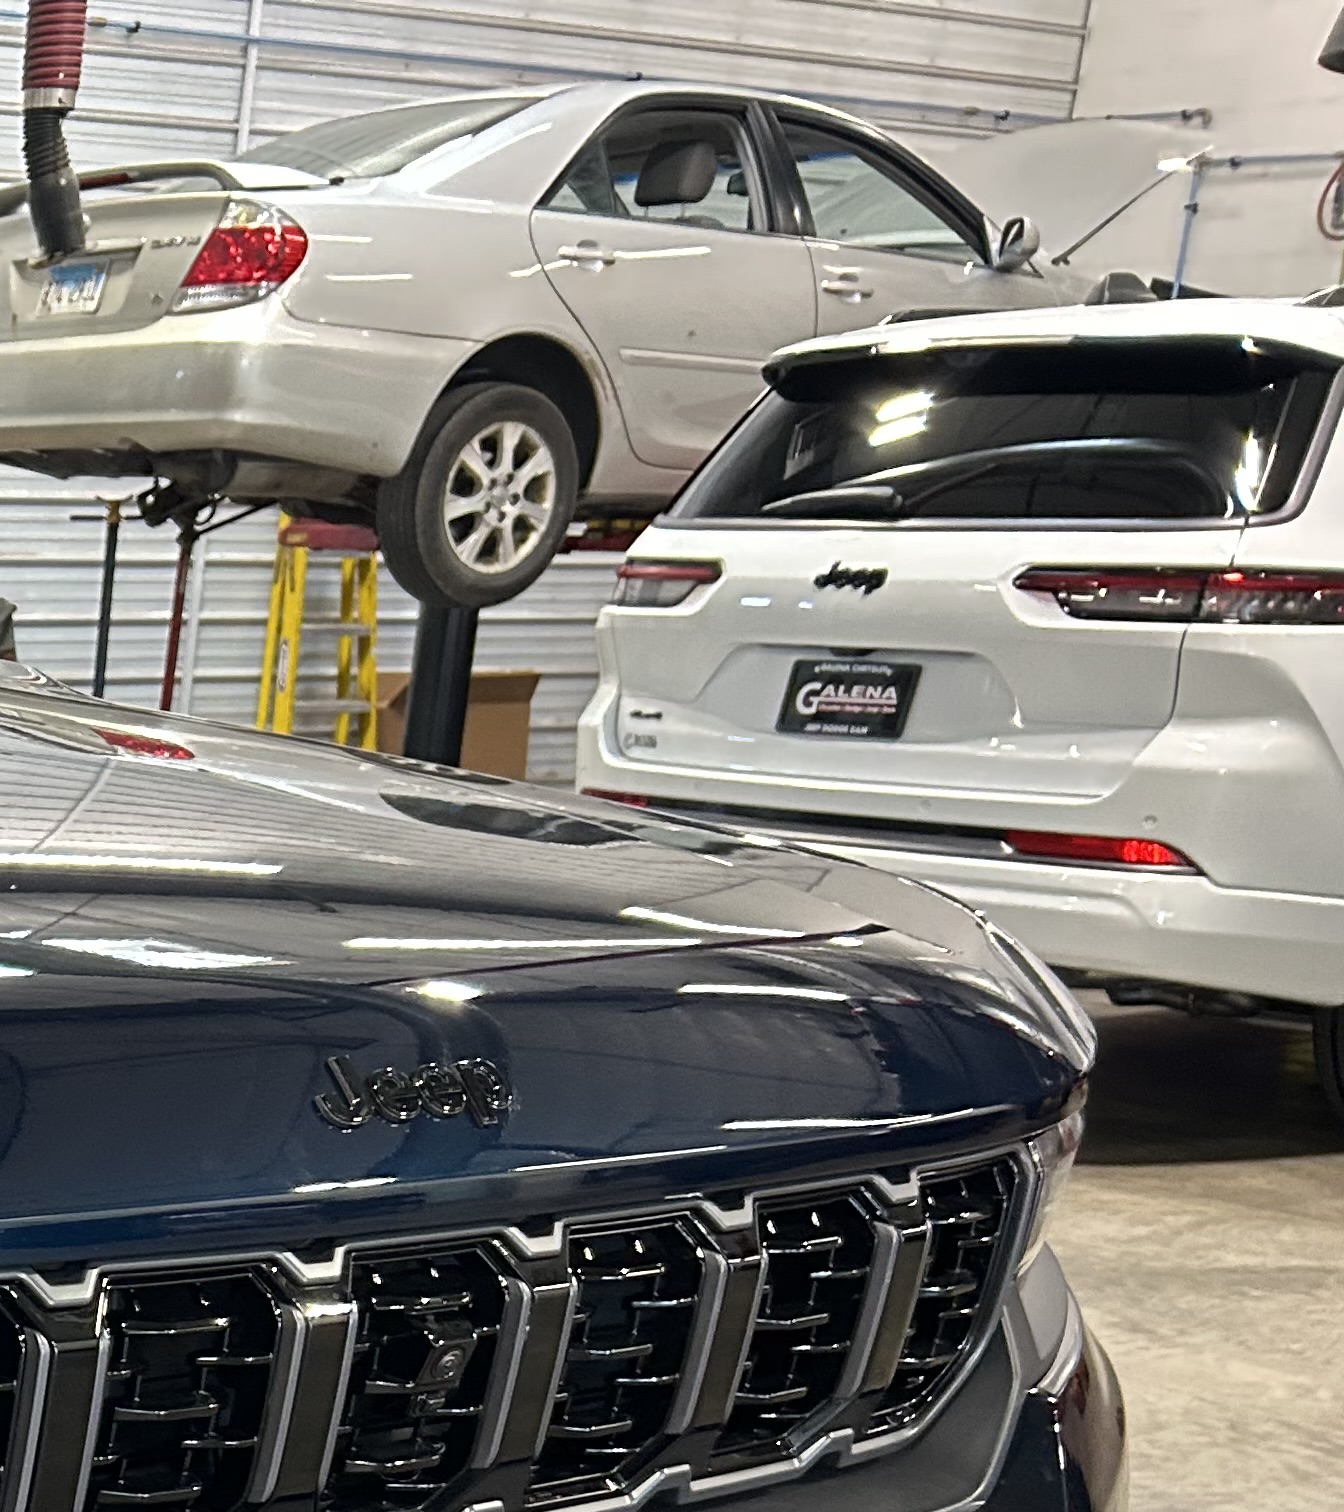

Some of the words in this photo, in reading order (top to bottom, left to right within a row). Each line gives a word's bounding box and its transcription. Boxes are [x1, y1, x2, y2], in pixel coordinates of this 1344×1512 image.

[813, 560, 889, 597] Jeep
[795, 681, 898, 716] GALENA
[315, 1054, 514, 1128] Jeep
